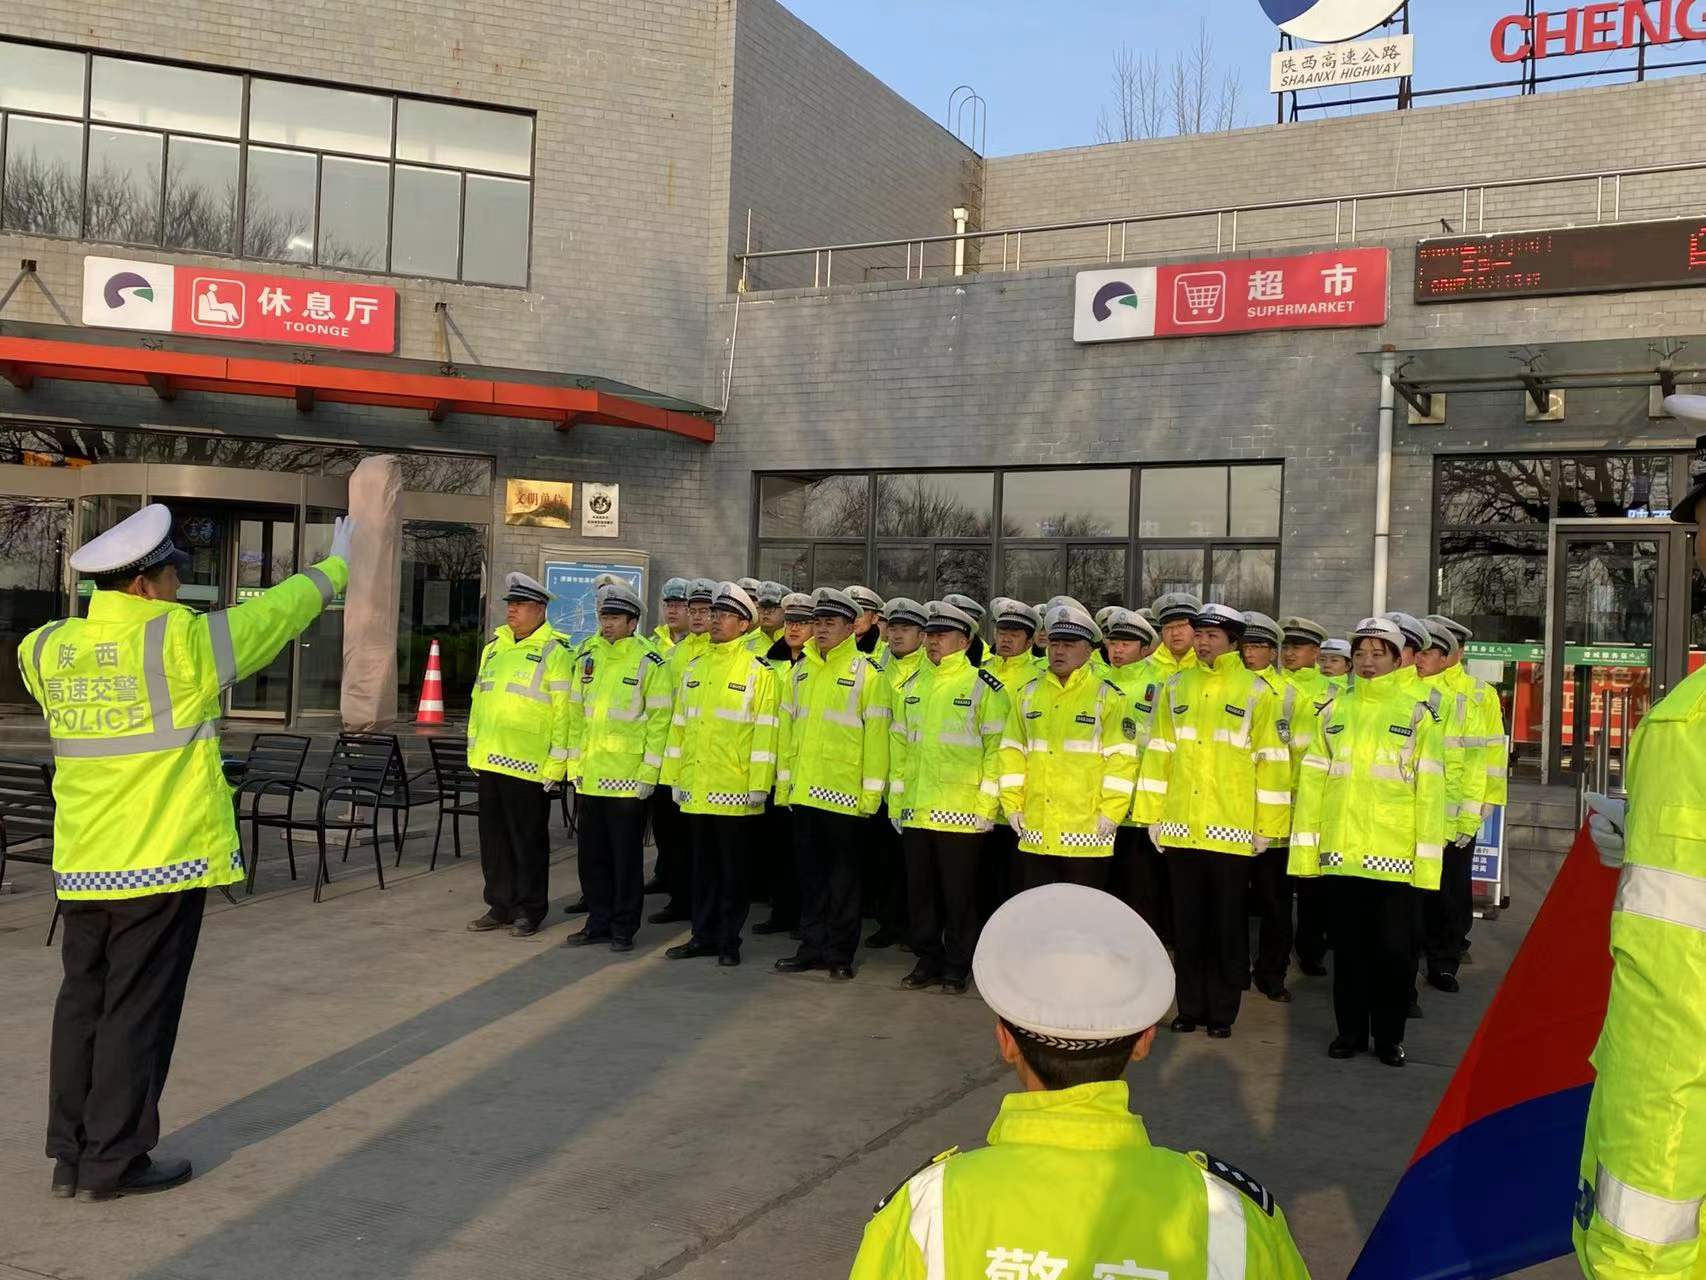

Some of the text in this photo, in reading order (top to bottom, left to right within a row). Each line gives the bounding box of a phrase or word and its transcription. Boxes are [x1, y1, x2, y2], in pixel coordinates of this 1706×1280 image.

[1281, 44, 1401, 74] 陕西高速公路
[1280, 62, 1400, 87] SHAANXI HIGHWAY
[1247, 263, 1358, 301] 超市
[257, 286, 379, 325] 休息厅
[1247, 301, 1355, 318] SUPERMARKET
[283, 320, 350, 338] TOONGE
[57, 642, 119, 670] 陕西
[45, 675, 138, 703] 高速交警
[50, 704, 146, 732] POLICE
